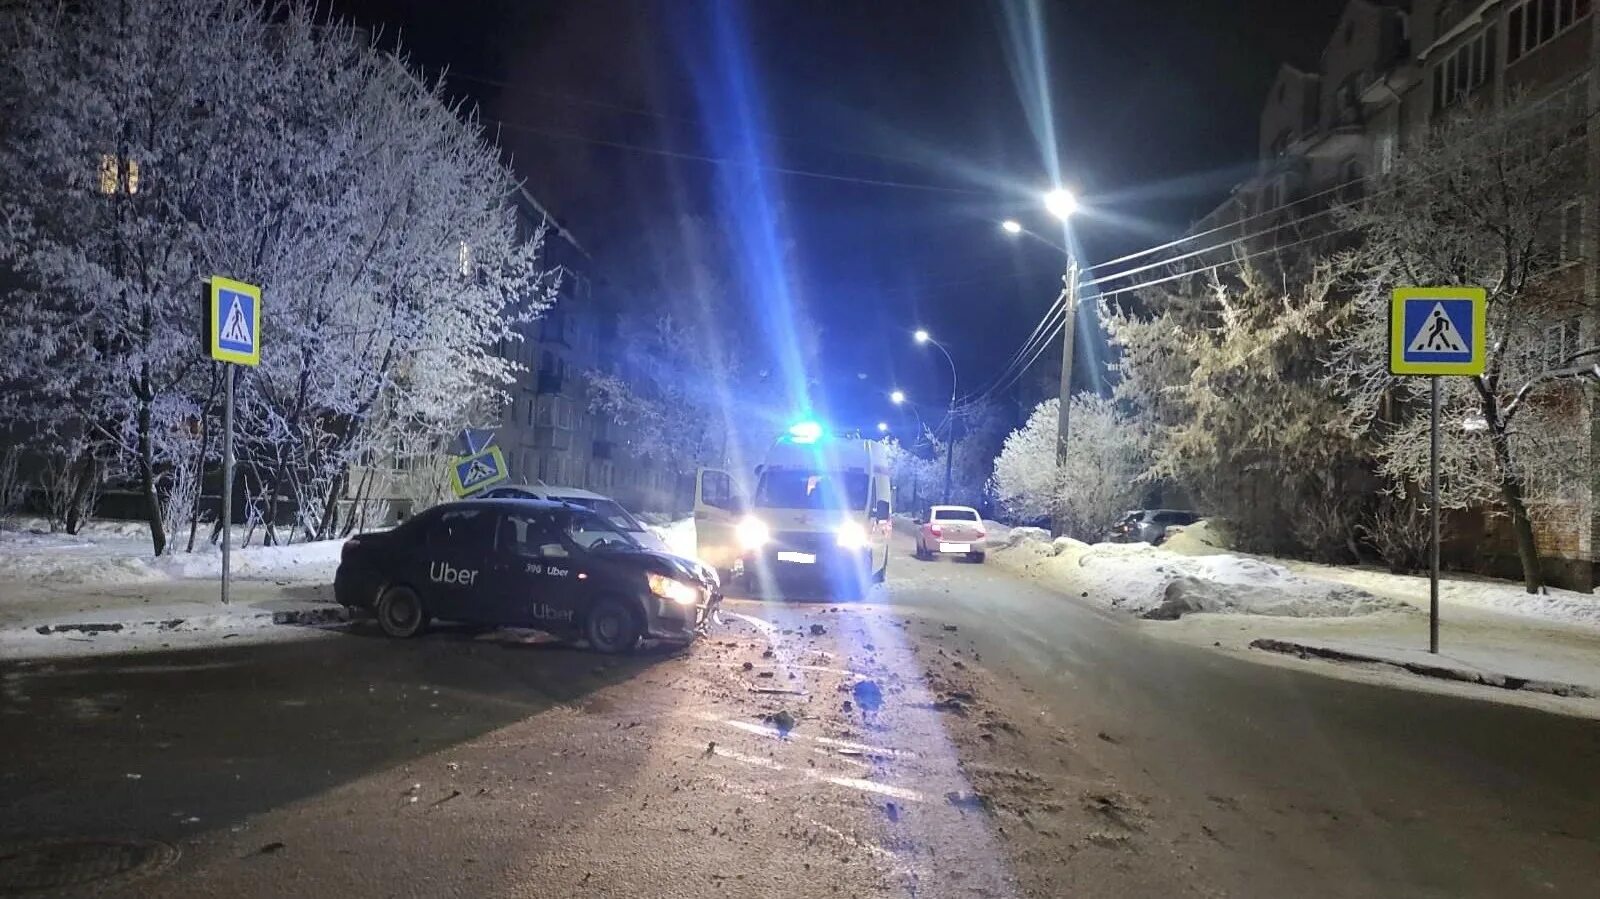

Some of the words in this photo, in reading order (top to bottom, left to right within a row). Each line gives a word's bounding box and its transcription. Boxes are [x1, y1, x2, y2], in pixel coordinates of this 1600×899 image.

[430, 561, 479, 586] Uber
[547, 566, 569, 577] Uber
[533, 602, 574, 622] Uber
